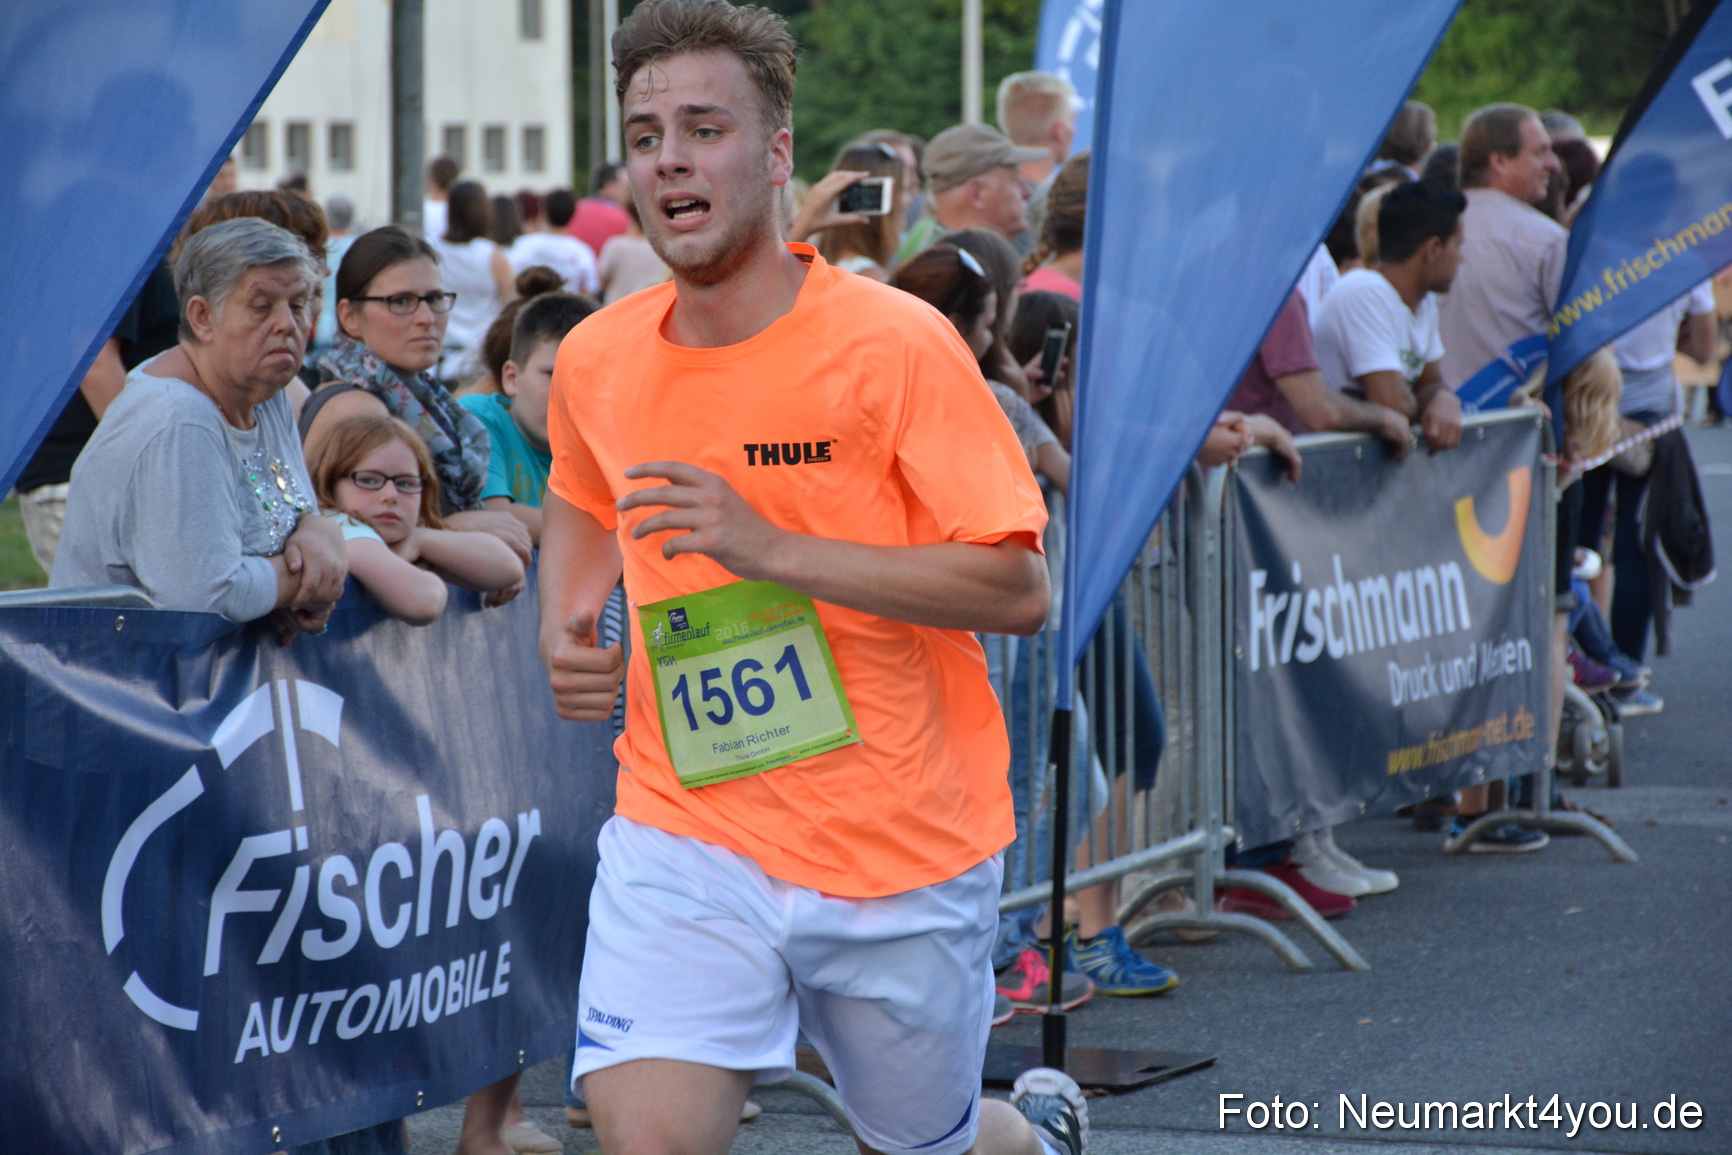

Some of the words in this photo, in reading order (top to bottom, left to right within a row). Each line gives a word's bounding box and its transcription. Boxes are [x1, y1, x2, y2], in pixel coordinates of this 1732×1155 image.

[743, 441, 832, 466] THULE
[664, 621, 711, 645] firmenlauf
[715, 621, 750, 641] 2016
[1249, 554, 1472, 672] Frischmann
[671, 644, 812, 731] 1561
[1387, 651, 1439, 707] Druck
[1440, 641, 1476, 694] und
[712, 738, 745, 754] Fabian
[746, 725, 791, 747] Richter
[735, 751, 750, 761] Thule
[751, 746, 771, 759] GmbH
[203, 794, 541, 977] Fischer
[233, 941, 511, 1064] AUTOMOBILE
[586, 1006, 634, 1033] SPALDING
